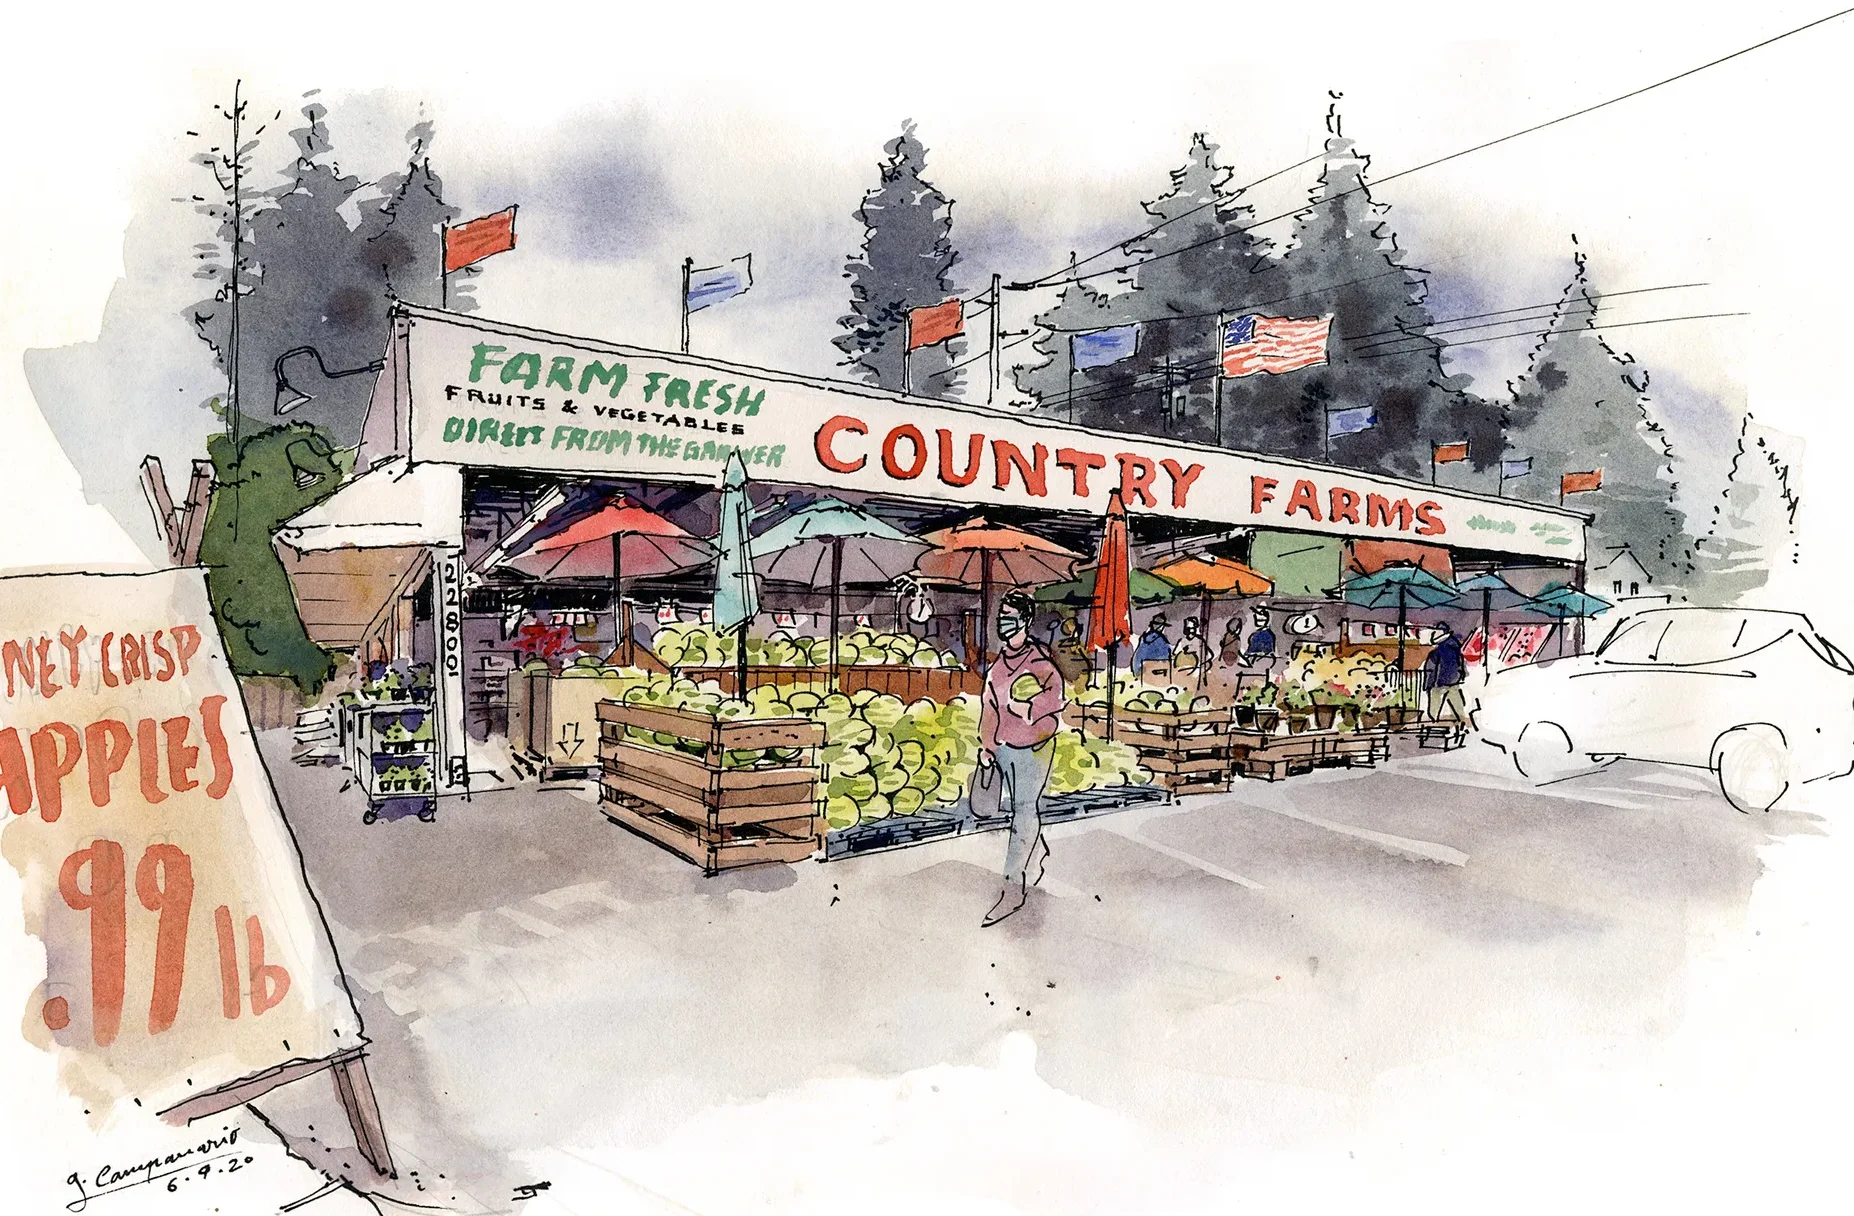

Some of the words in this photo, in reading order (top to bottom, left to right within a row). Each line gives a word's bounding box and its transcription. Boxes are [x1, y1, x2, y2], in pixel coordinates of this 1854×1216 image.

[445, 385, 545, 410] FRUITS
[562, 400, 578, 414] &
[594, 405, 744, 435] VEGETABLES
[468, 342, 627, 396] FARM
[644, 372, 765, 416] FRESH
[550, 425, 632, 456] FROM
[639, 434, 680, 457] THE
[814, 415, 1204, 509] COUNTRY
[1251, 476, 1446, 536] FARMS
[2, 626, 87, 697] NEY
[101, 625, 201, 687] CRISP
[0, 695, 233, 823] APPLES
